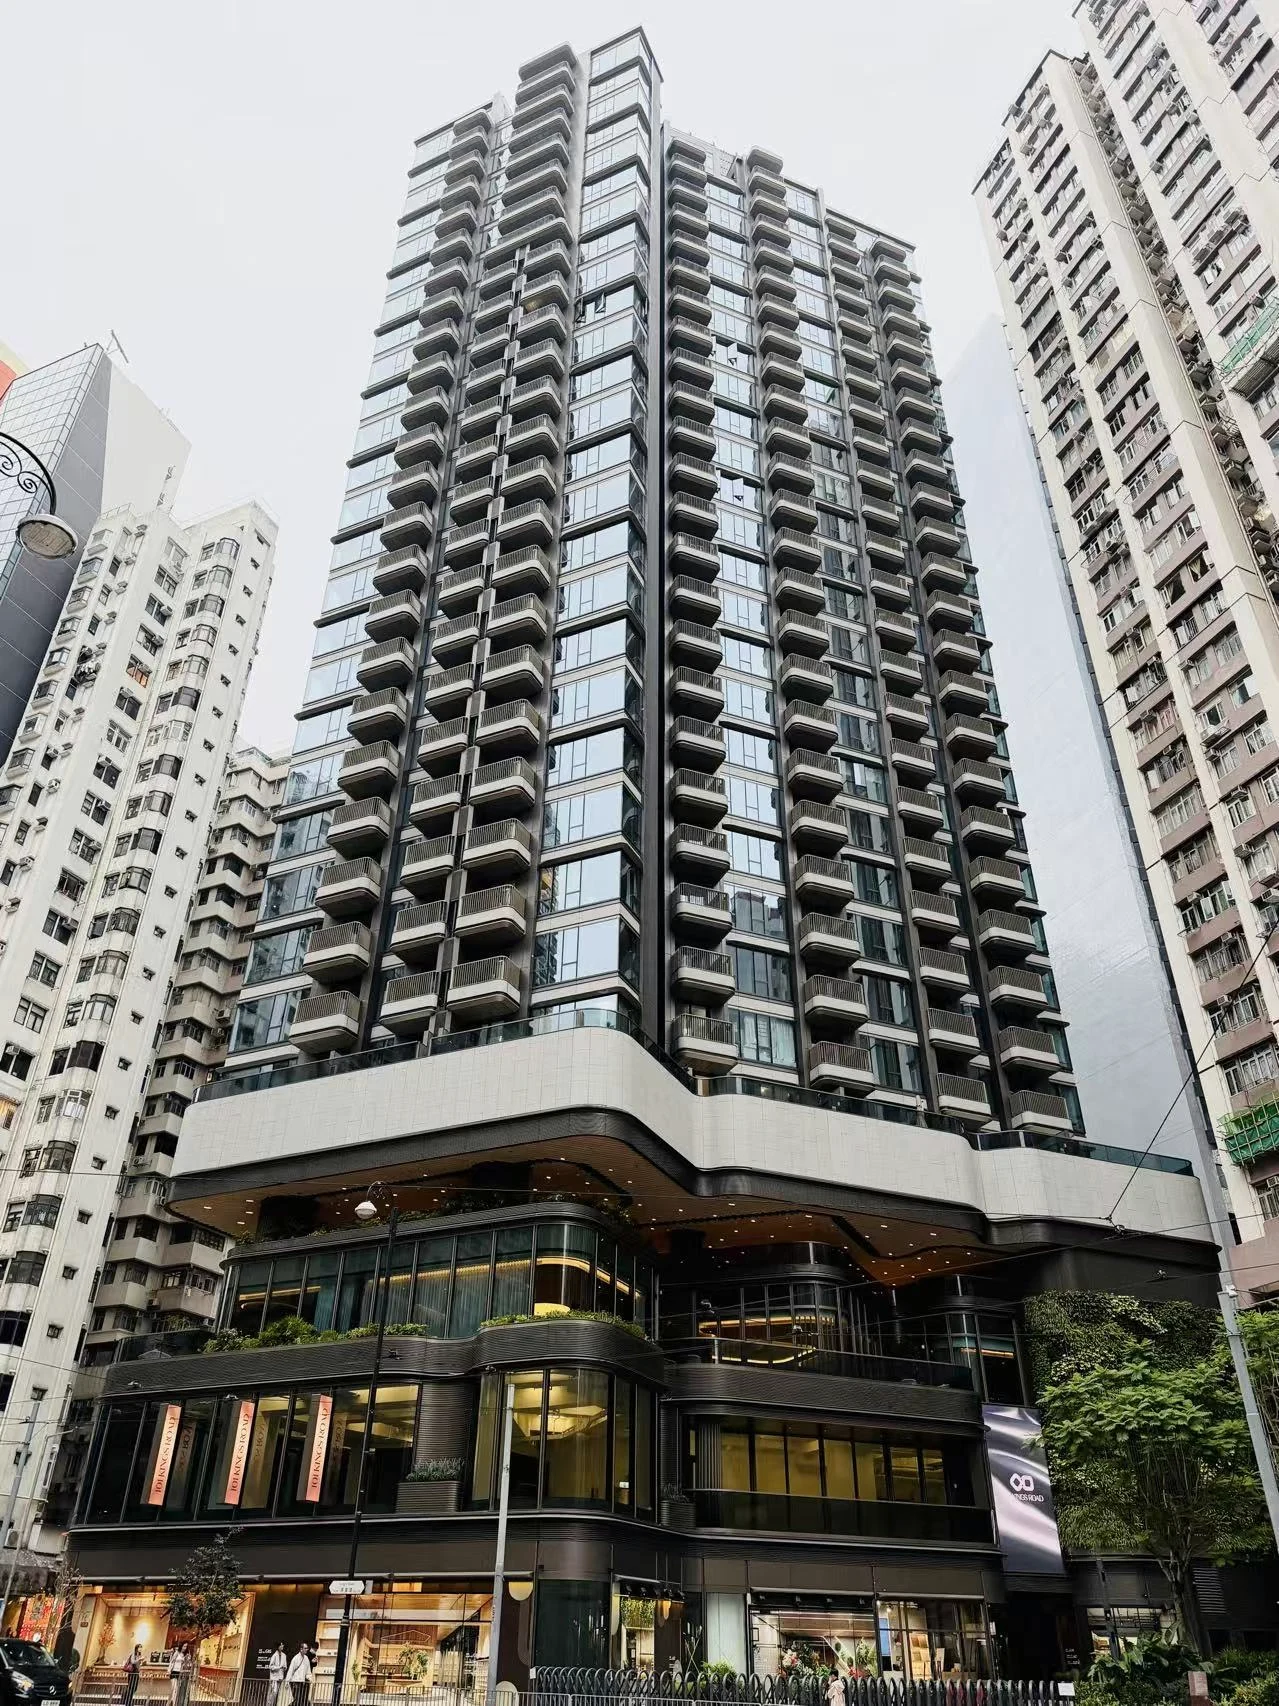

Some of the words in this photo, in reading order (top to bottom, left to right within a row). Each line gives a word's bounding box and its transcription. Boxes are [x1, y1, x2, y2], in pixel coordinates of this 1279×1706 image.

[157, 1447, 170, 1478] KINGS
[164, 1416, 176, 1446] ROAD
[233, 1445, 245, 1476] KINGS
[240, 1413, 250, 1443] ROAD
[313, 1441, 324, 1472] KINGS
[319, 1408, 329, 1439] ROAD
